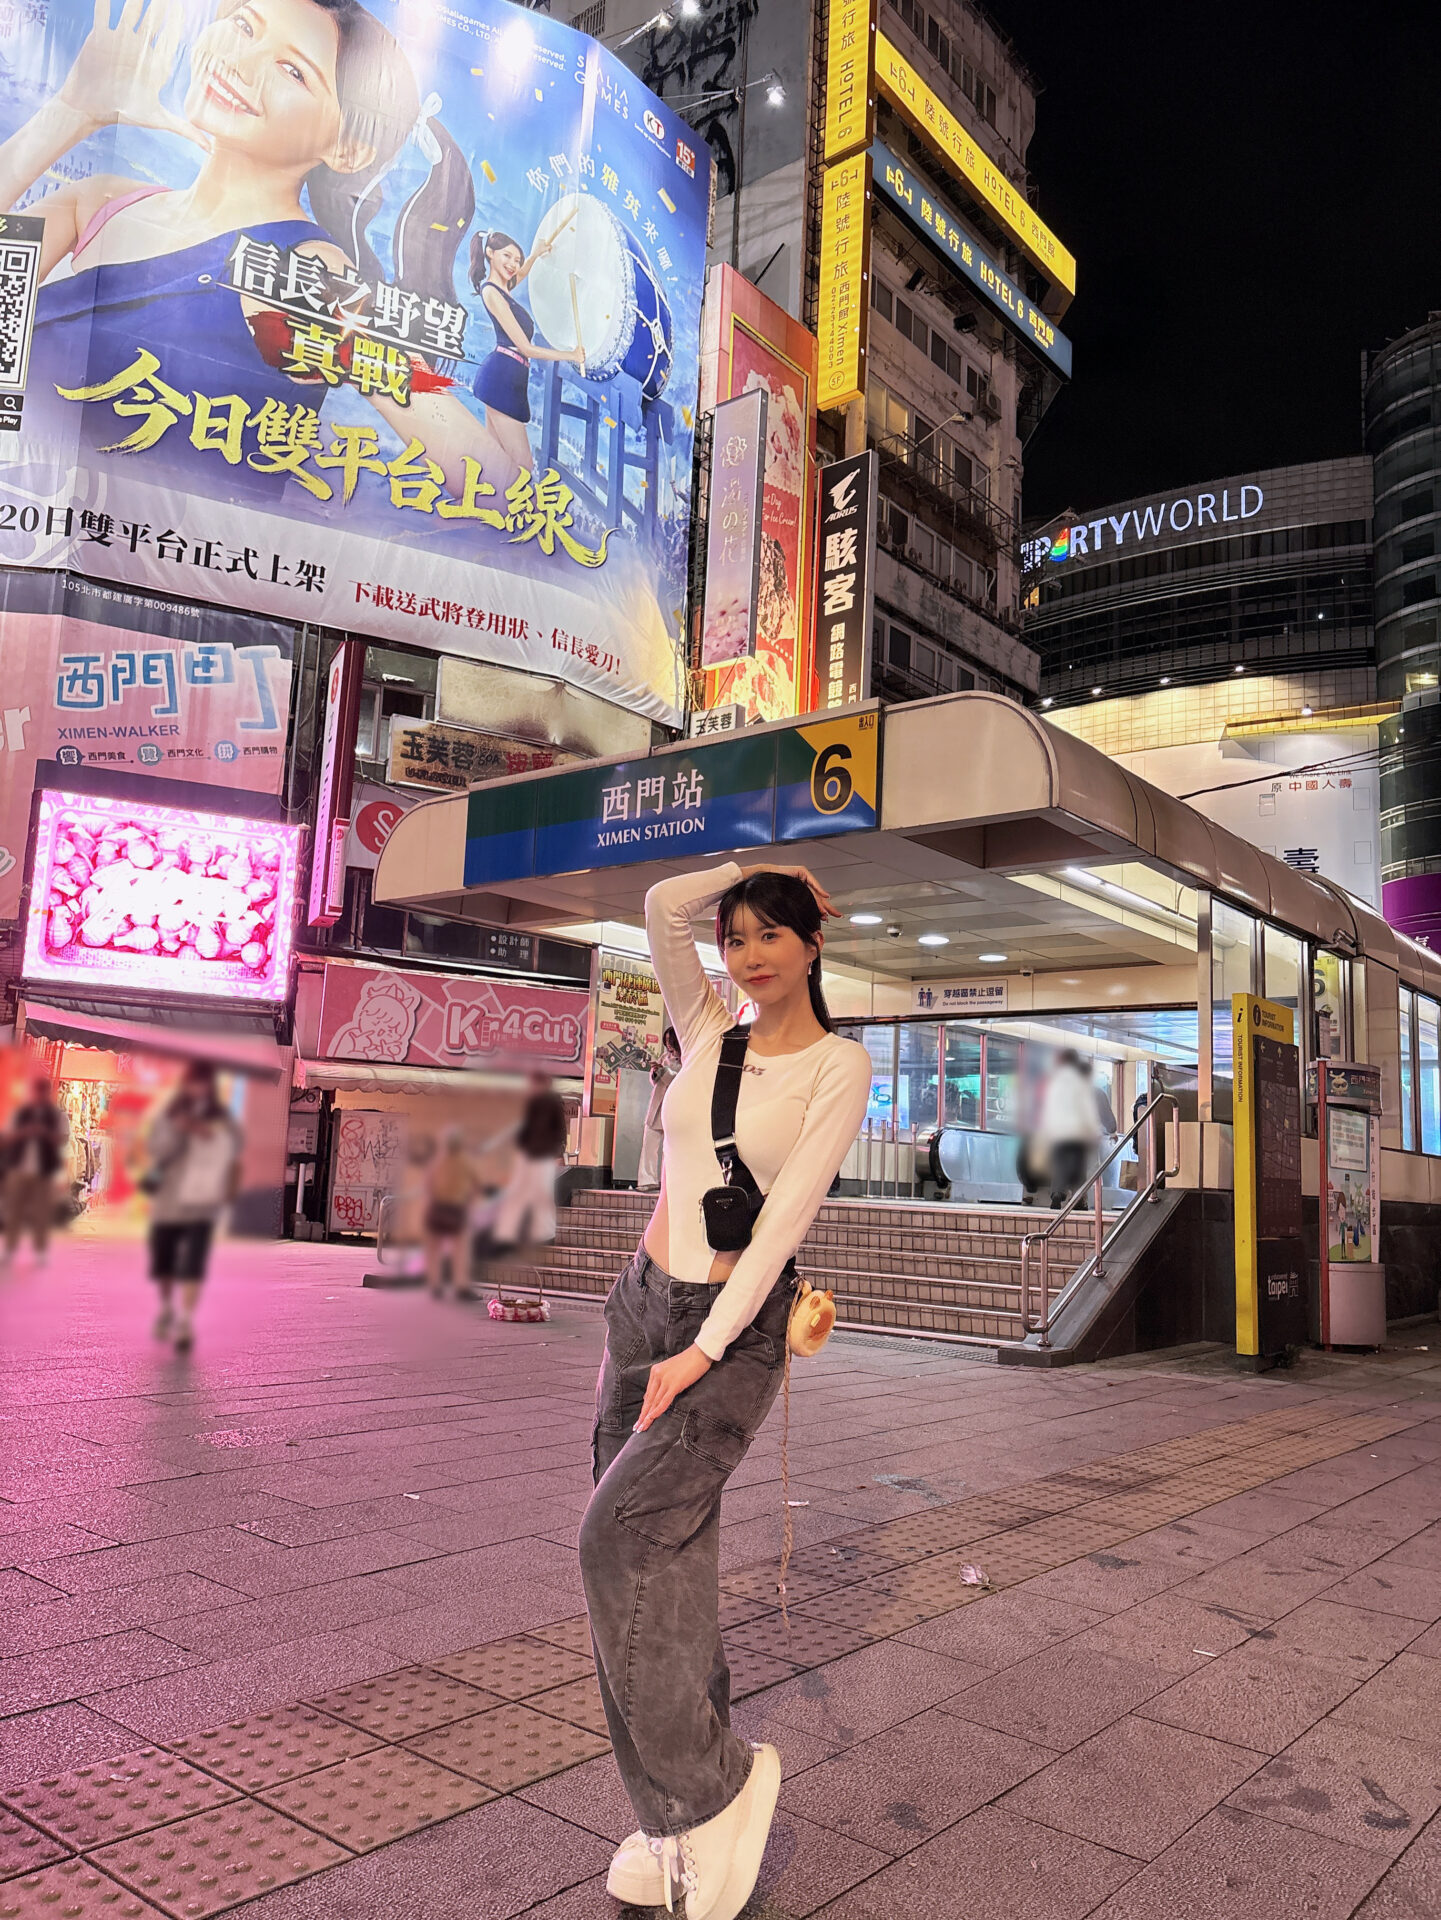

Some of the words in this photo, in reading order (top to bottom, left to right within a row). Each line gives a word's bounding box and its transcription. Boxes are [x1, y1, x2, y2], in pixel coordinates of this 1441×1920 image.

[839, 60, 854, 124] HOTEL
[837, 126, 853, 139] 6
[924, 98, 975, 171] 陸號行旅
[984, 167, 1017, 219] HOTEL
[1020, 209, 1026, 229] 6
[833, 191, 851, 281] 陸號行旅
[921, 197, 972, 268] 陸號行旅
[229, 234, 467, 356] 信長之野望
[980, 260, 1015, 311] HOTEL
[1017, 299, 1024, 319] 6
[281, 319, 410, 405] 真戰
[836, 321, 849, 366] Ximen
[3, 415, 18, 426] Play
[53, 347, 621, 569] 今日雙平台上線
[825, 504, 859, 524] AORUS
[0, 503, 327, 594] 20日雙平台正式上架
[822, 527, 858, 617] 駭客
[55, 644, 280, 730] 西門町
[57, 724, 180, 740] XIMEN-WALKER
[167, 749, 204, 758] 西門文化
[400, 730, 476, 771] 玉芙蓉
[695, 712, 733, 738] 玉芙蓉
[602, 769, 704, 825] 西門站
[812, 743, 853, 814] 6
[1288, 778, 1353, 792] 中國人壽
[597, 827, 641, 848] XIMEN
[644, 816, 706, 840] STATION
[499, 934, 530, 948] 設計師
[1267, 1275, 1288, 1301] taipei
